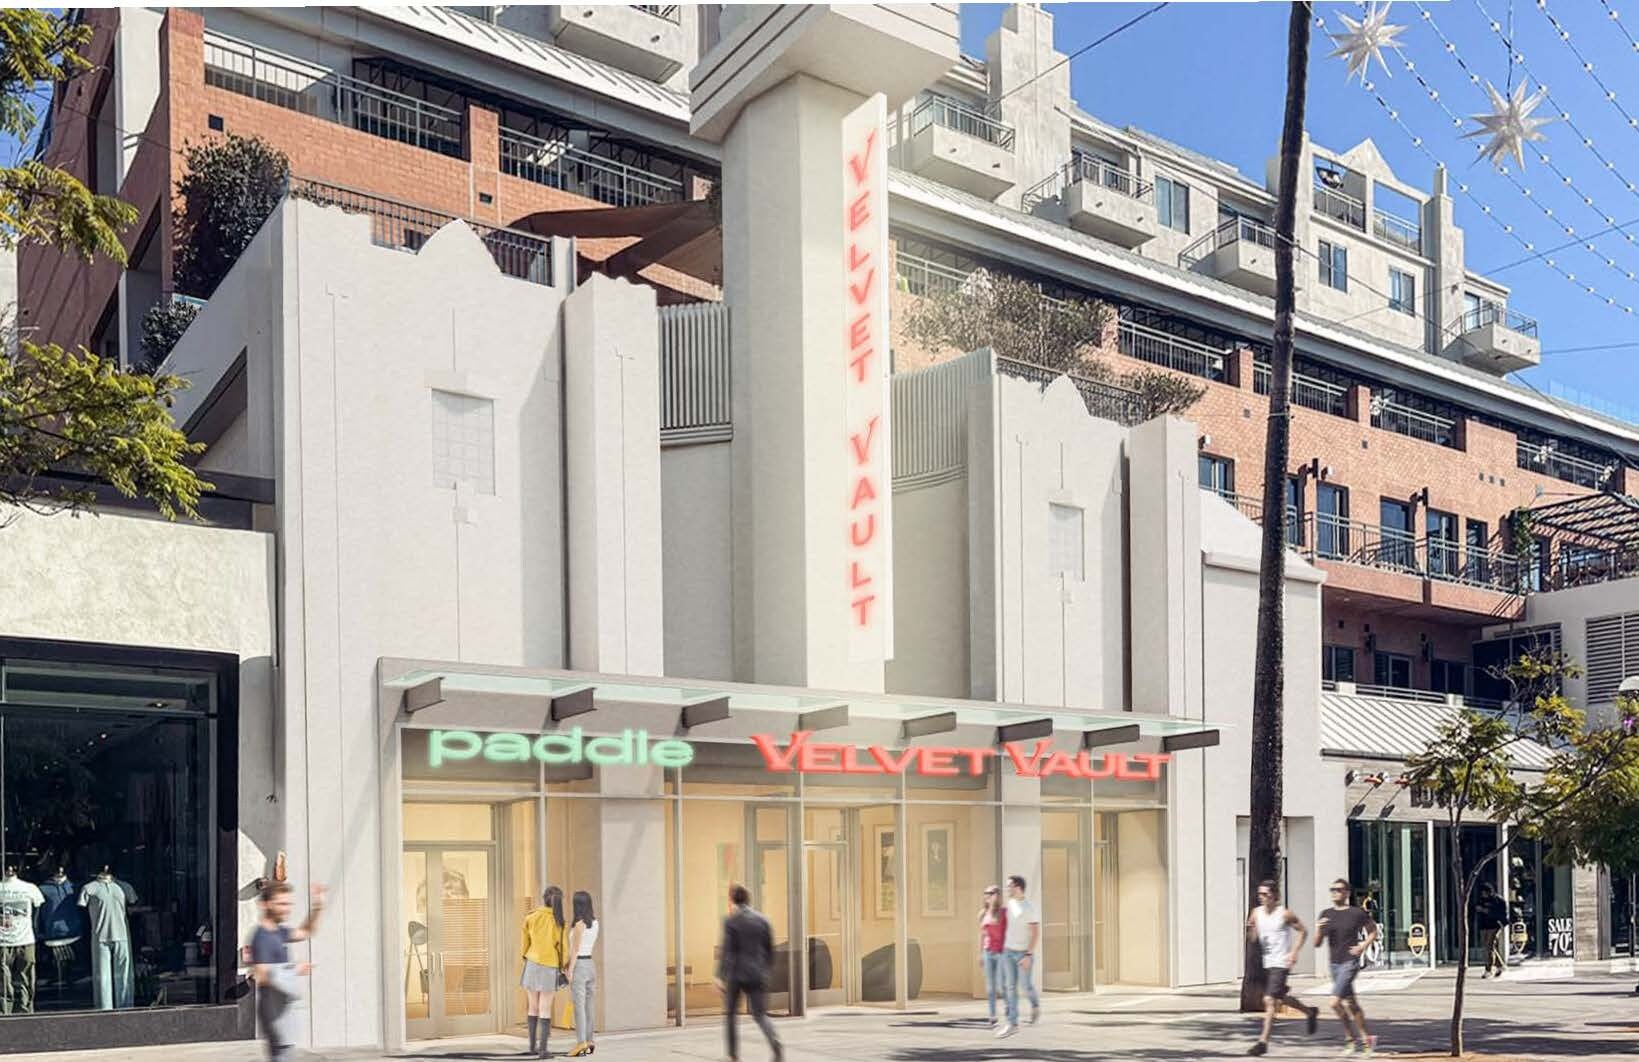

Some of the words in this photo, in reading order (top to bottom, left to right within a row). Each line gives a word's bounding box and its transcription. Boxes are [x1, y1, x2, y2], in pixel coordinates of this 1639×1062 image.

[848, 128, 877, 383] VELVET
[849, 415, 880, 626] VAULT
[428, 726, 695, 768] paddle
[750, 731, 996, 776] VELVET
[1001, 738, 1170, 781] VAULT
[1548, 918, 1573, 932] SALE
